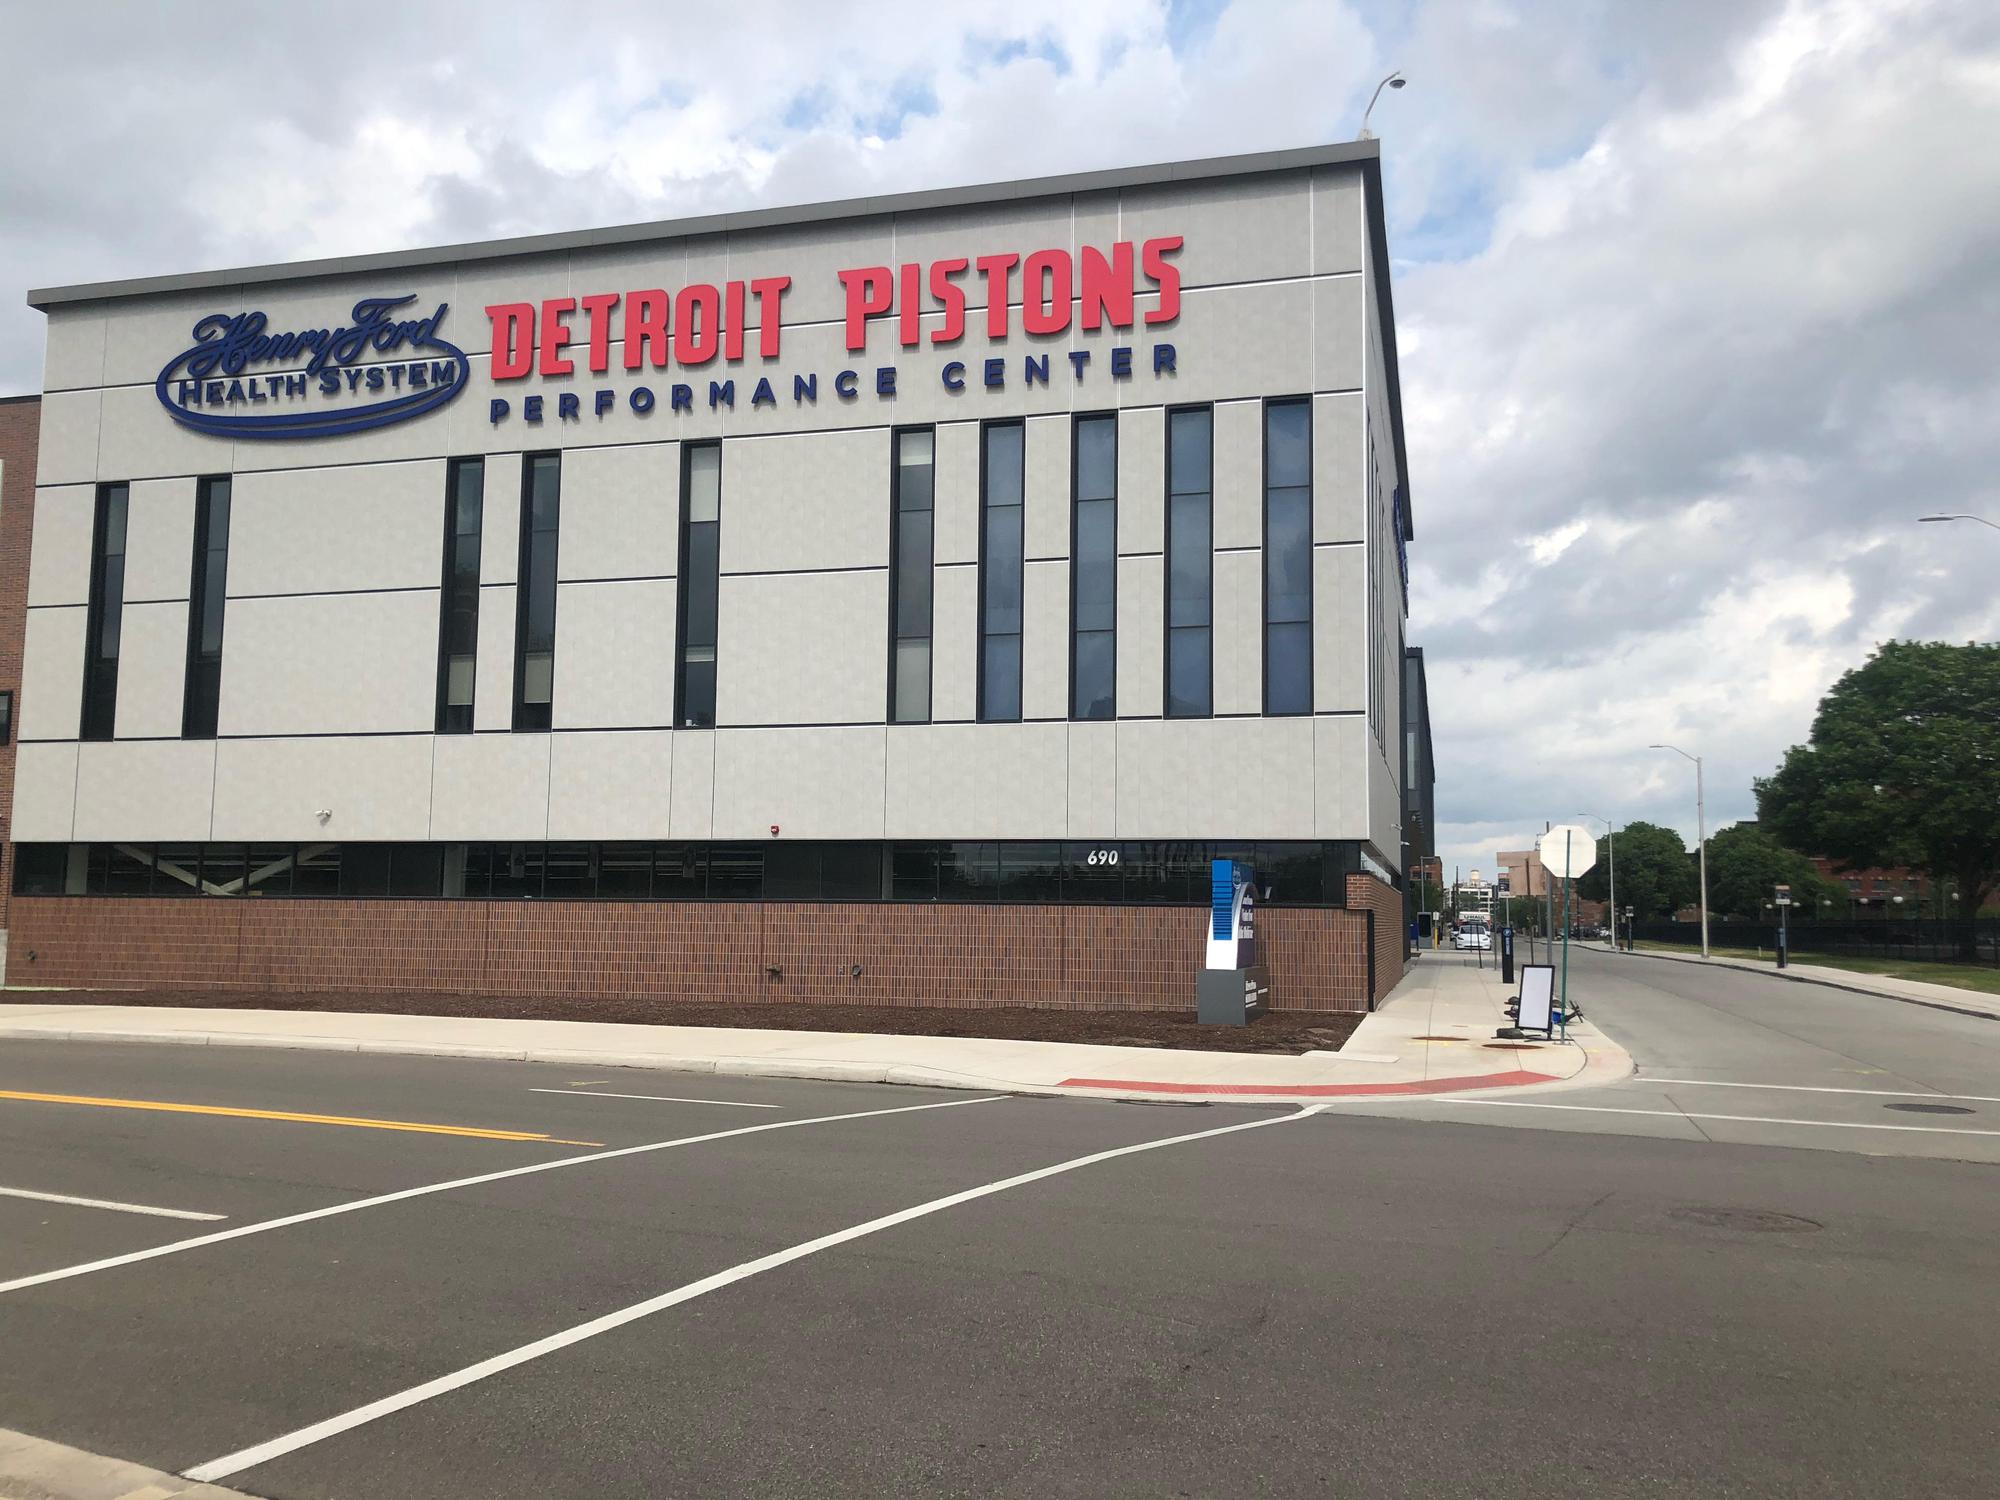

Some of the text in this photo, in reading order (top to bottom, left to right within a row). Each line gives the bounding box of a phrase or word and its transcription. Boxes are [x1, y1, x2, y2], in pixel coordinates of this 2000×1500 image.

[187, 294, 448, 377] Henry Ford
[485, 236, 1184, 380] DETROIT PISTONS
[178, 361, 455, 405] HEALTH SYSTEM
[491, 344, 1177, 423] PERFORMANCE CENTER
[1087, 850, 1118, 865] 690
